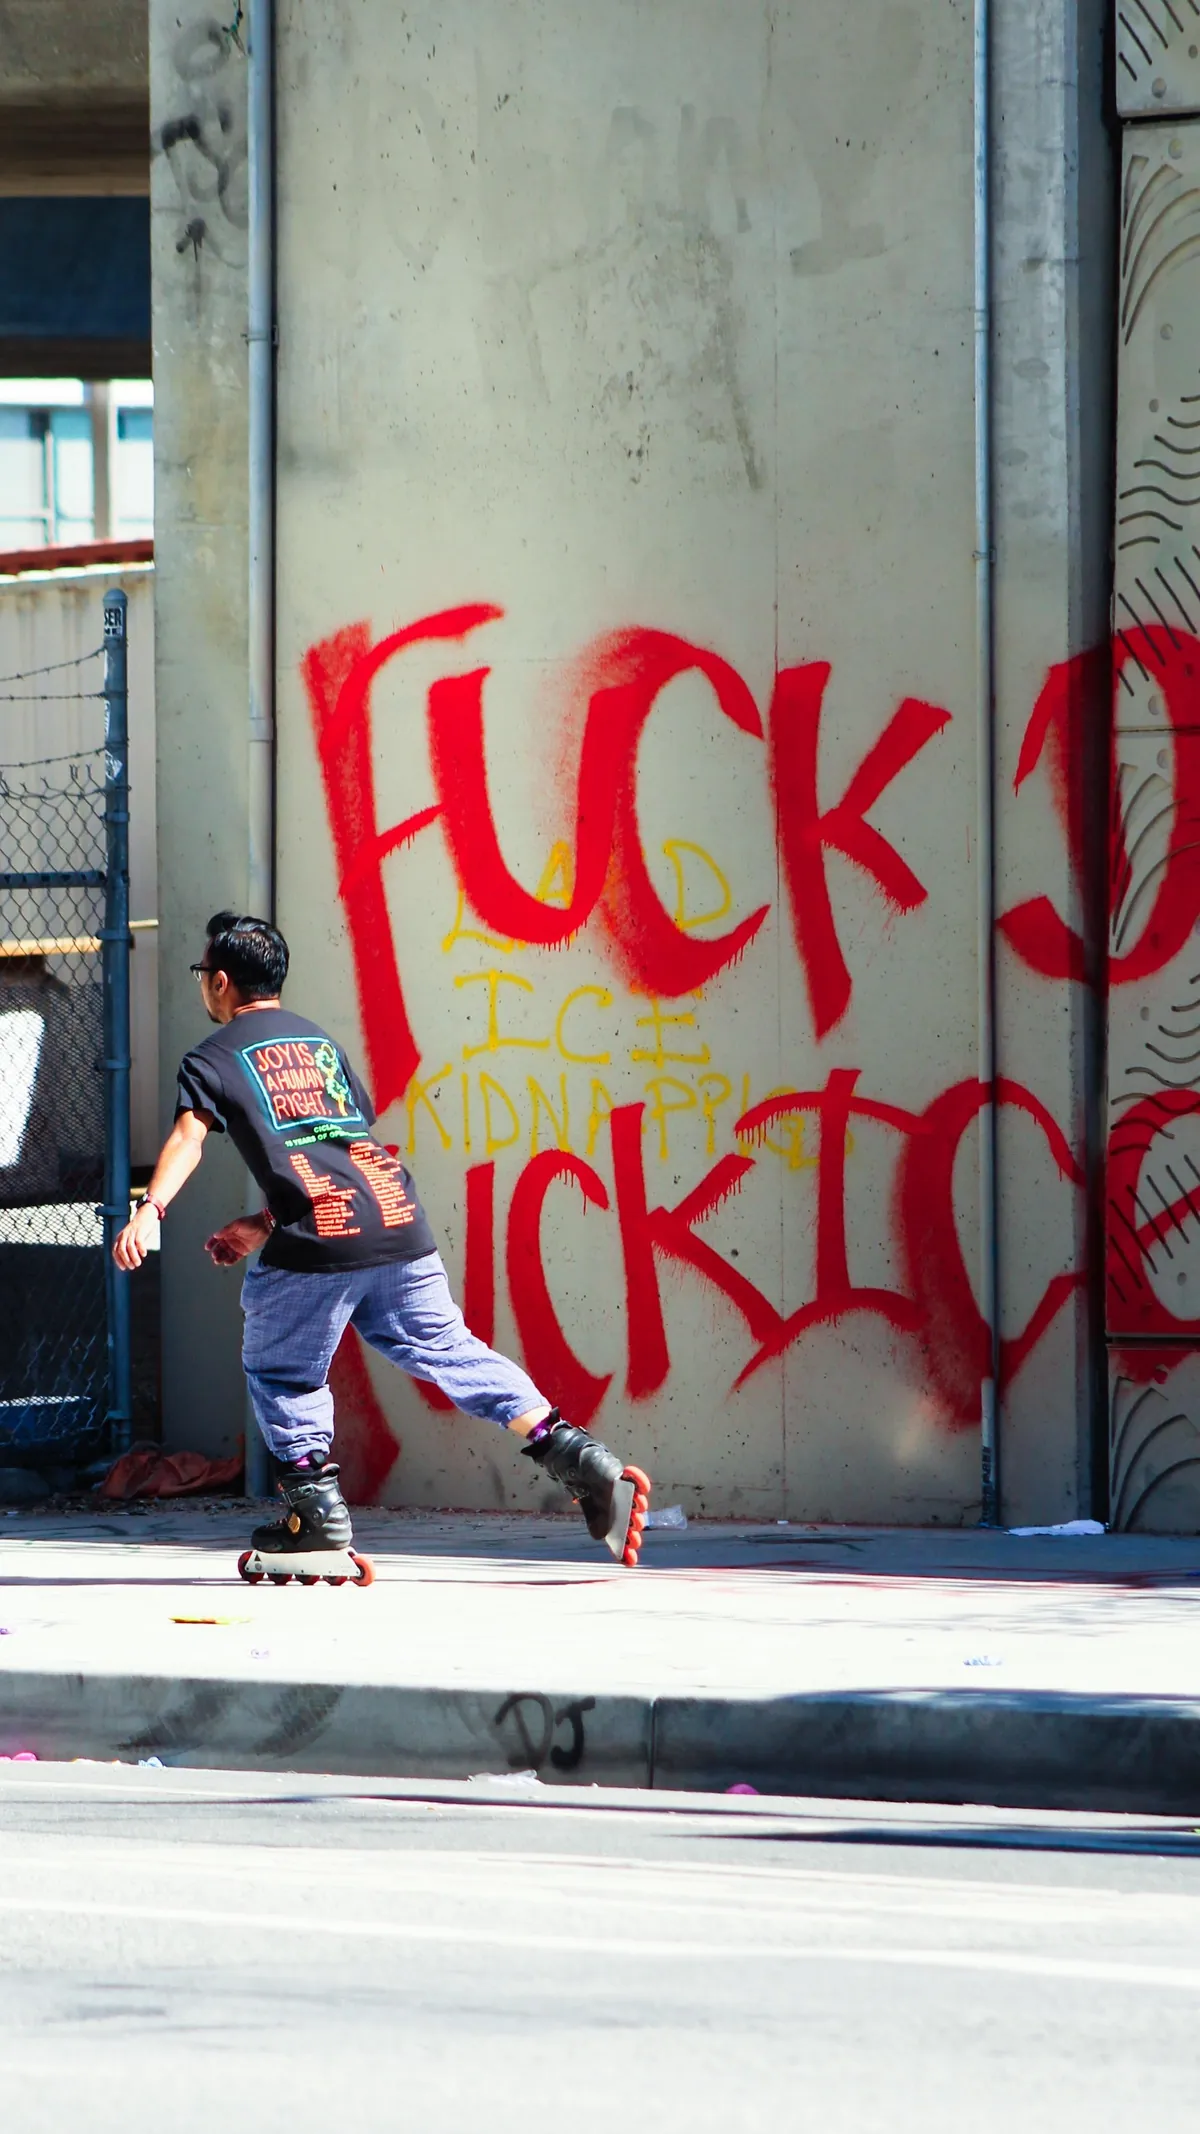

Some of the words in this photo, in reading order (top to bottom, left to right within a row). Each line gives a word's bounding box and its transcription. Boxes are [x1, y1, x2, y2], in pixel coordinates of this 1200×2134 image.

[302, 602, 952, 1120] FUCK
[441, 838, 732, 953] LAD
[453, 967, 711, 1070] ICE
[256, 1043, 293, 1072] JOY
[292, 1043, 315, 1066] IS
[266, 1073, 279, 1092] A
[276, 1068, 325, 1091] HUMAN
[273, 1090, 333, 1120] RIGHT.
[292, 1135, 317, 1146] YEARS
[317, 1133, 328, 1141] OF
[332, 1102, 786, 1505] UCK
